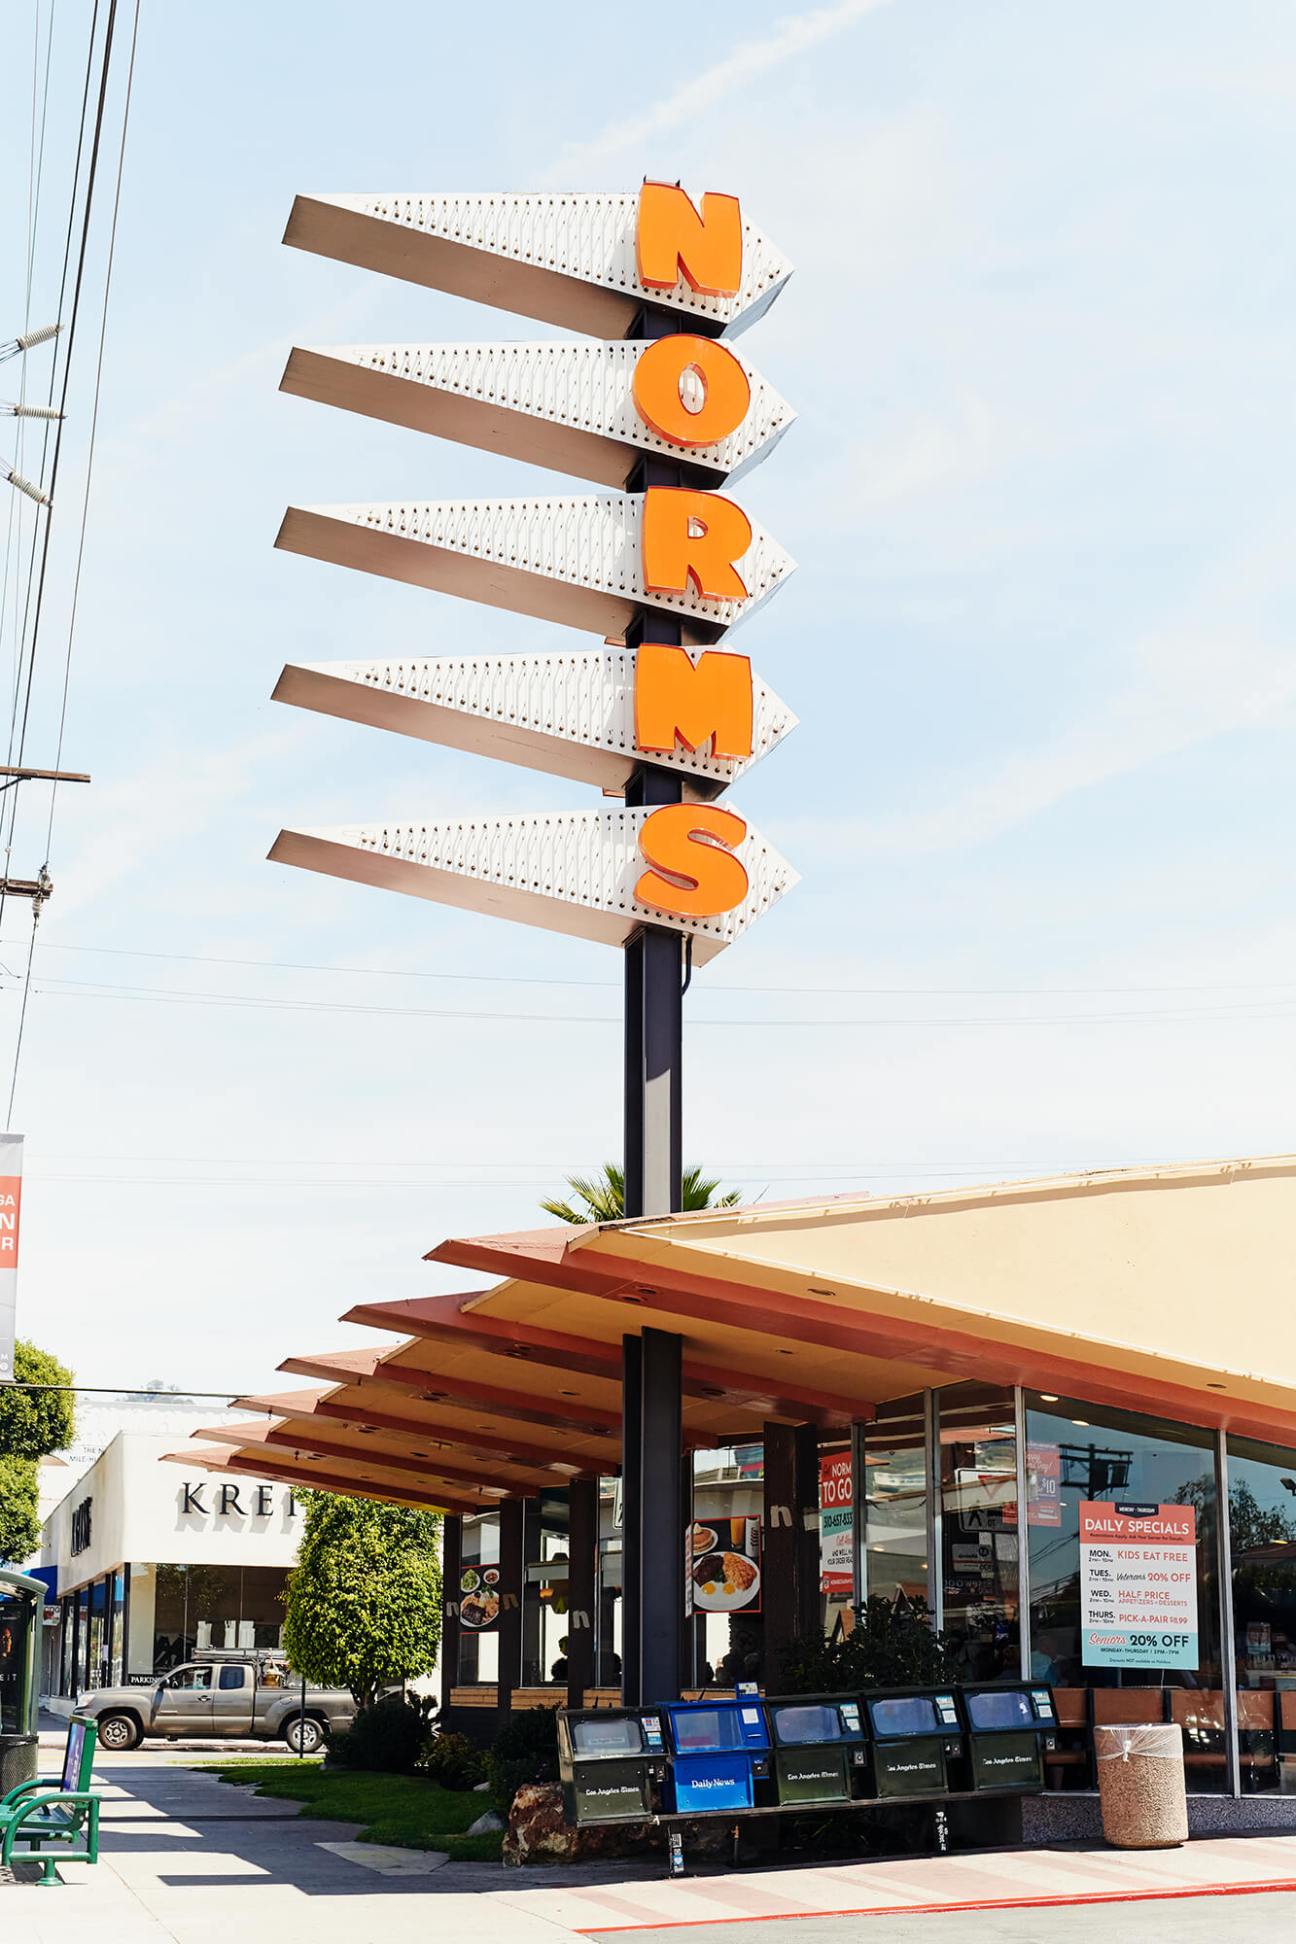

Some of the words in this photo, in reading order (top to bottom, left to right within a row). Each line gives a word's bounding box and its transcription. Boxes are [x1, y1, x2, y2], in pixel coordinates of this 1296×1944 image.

[632, 177, 753, 919] NORMS
[823, 1480, 835, 1503] TO
[837, 1478, 853, 1501] GO
[1085, 1518, 1124, 1532] DAILY
[1128, 1520, 1190, 1535] SPECIALS
[1117, 1550, 1140, 1560] KIDS
[1143, 1551, 1161, 1560] EAT
[1163, 1552, 1189, 1562] FREE
[1090, 1569, 1111, 1577] TUES.
[1147, 1572, 1169, 1582] 20%
[1170, 1573, 1191, 1583] OFF
[1118, 1590, 1143, 1599] HALF
[1144, 1591, 1170, 1600] PRICE
[1088, 1610, 1115, 1618] THURS.
[1088, 1631, 1127, 1645] Seniors
[1130, 1634, 1158, 1647] 20%
[1161, 1635, 1190, 1647] OFF
[691, 1779, 713, 1790] Daily
[713, 1778, 736, 1788] News
